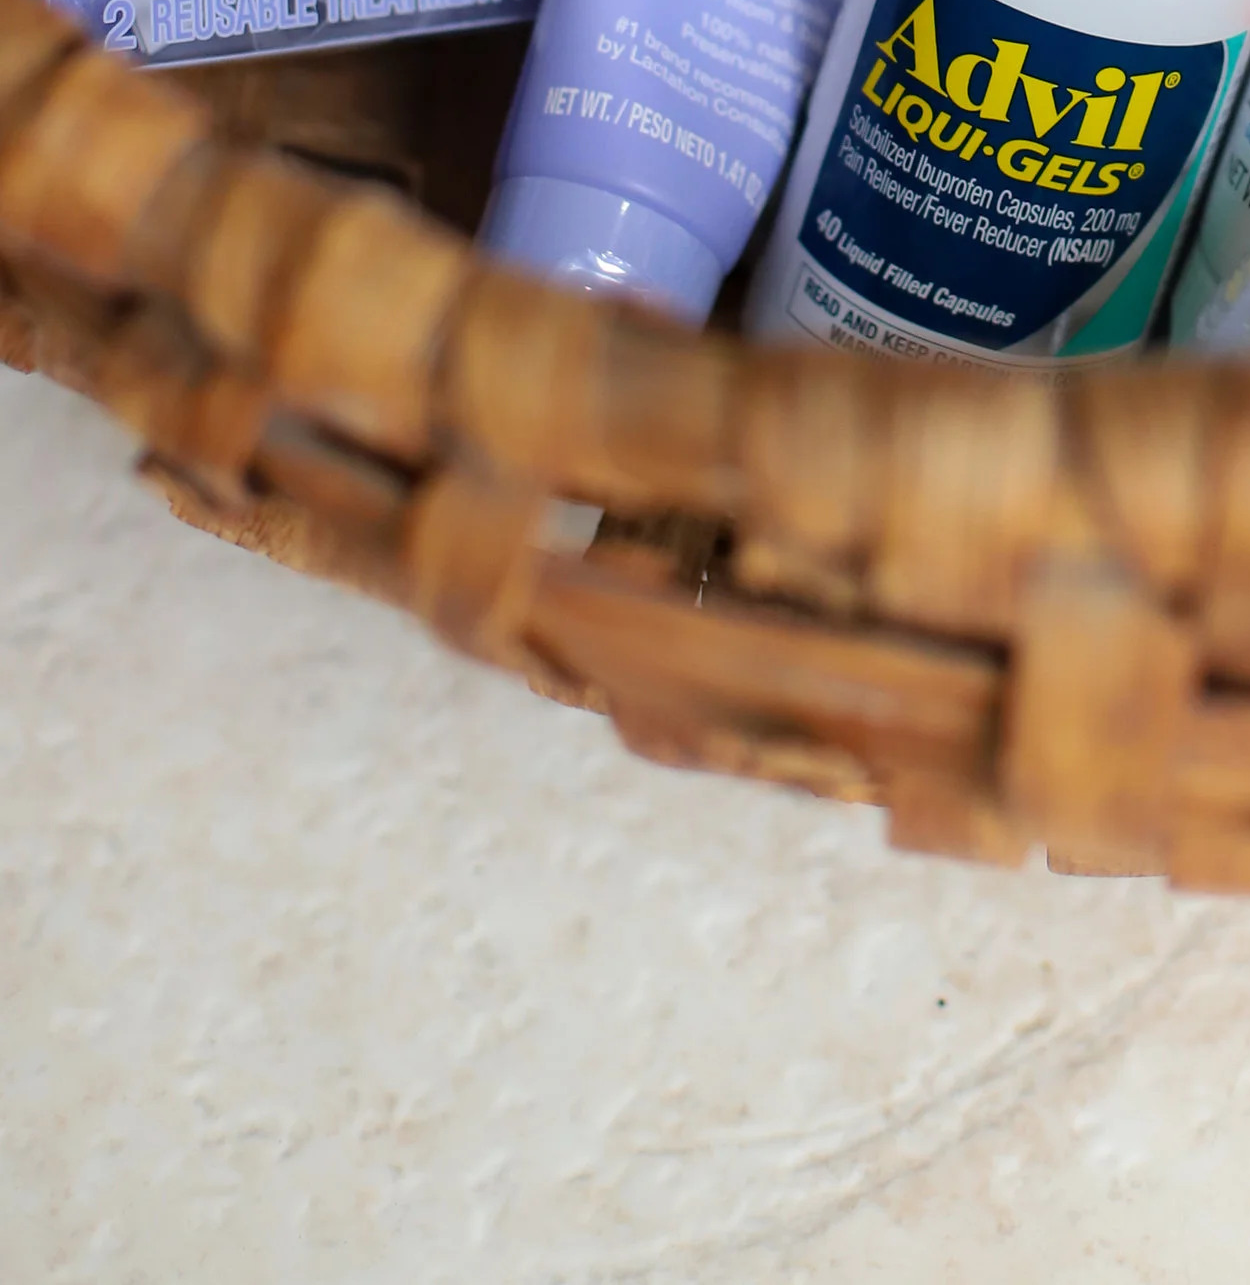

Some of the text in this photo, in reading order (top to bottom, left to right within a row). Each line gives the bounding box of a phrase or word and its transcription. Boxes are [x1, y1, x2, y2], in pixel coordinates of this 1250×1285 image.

[597, 34, 623, 60] by
[629, 43, 709, 107] Lactation
[615, 16, 638, 39] #1
[645, 28, 690, 75] brand
[544, 85, 574, 116] NET
[580, 90, 612, 122] WT.
[628, 101, 673, 145] PESO
[675, 126, 716, 170] NETO
[849, 103, 1142, 237] Solubilized Ibuprofen Capsules, 200 mg
[839, 135, 1116, 268] Pain Reliever/Fever Reducer (NSAID)
[816, 209, 1016, 328] 40 Liquid Filled Capsules
[803, 276, 841, 318] READ
[841, 310, 879, 340] AND
[881, 329, 930, 361] KEEP
